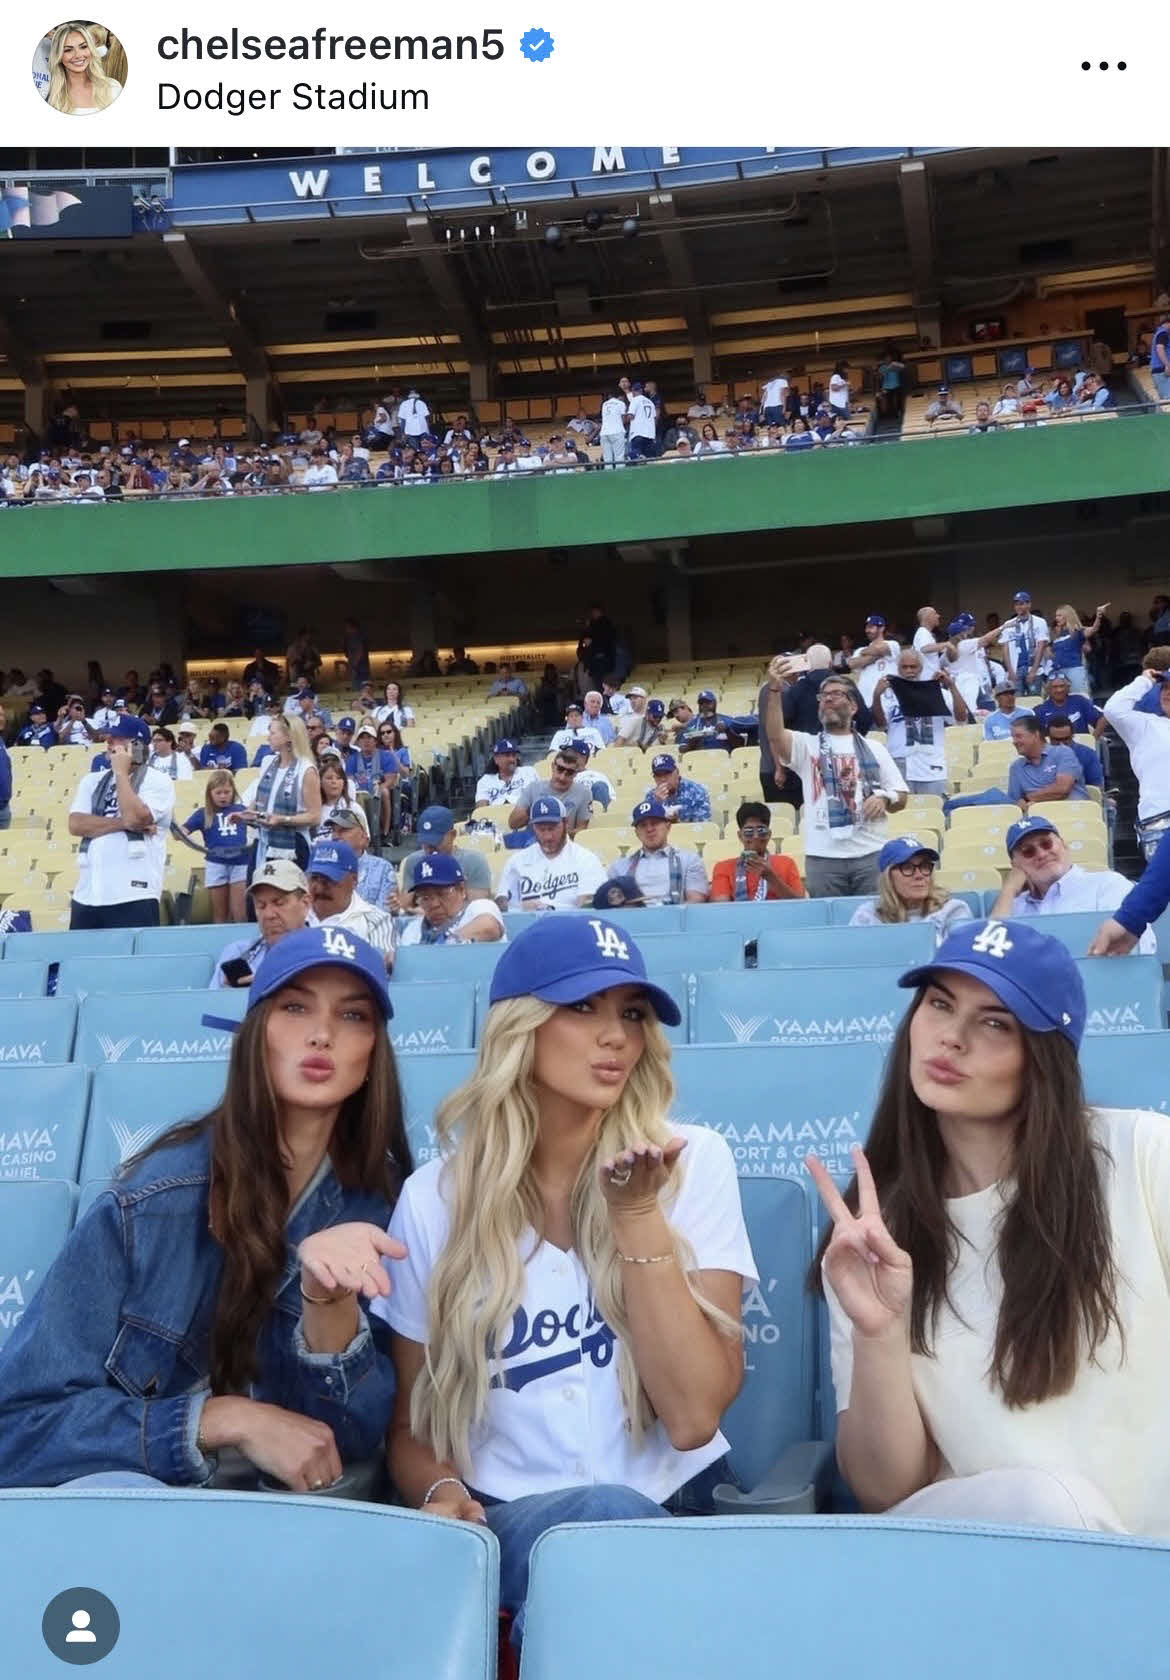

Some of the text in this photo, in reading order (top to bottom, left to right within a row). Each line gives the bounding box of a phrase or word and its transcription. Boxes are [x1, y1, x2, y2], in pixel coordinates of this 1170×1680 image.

[288, 145, 681, 199] WELCOME
[520, 872, 579, 900] Dodgers
[321, 927, 355, 960] LA
[588, 920, 630, 960] LA
[972, 919, 1013, 958] LA
[776, 1145, 787, 1159] &
